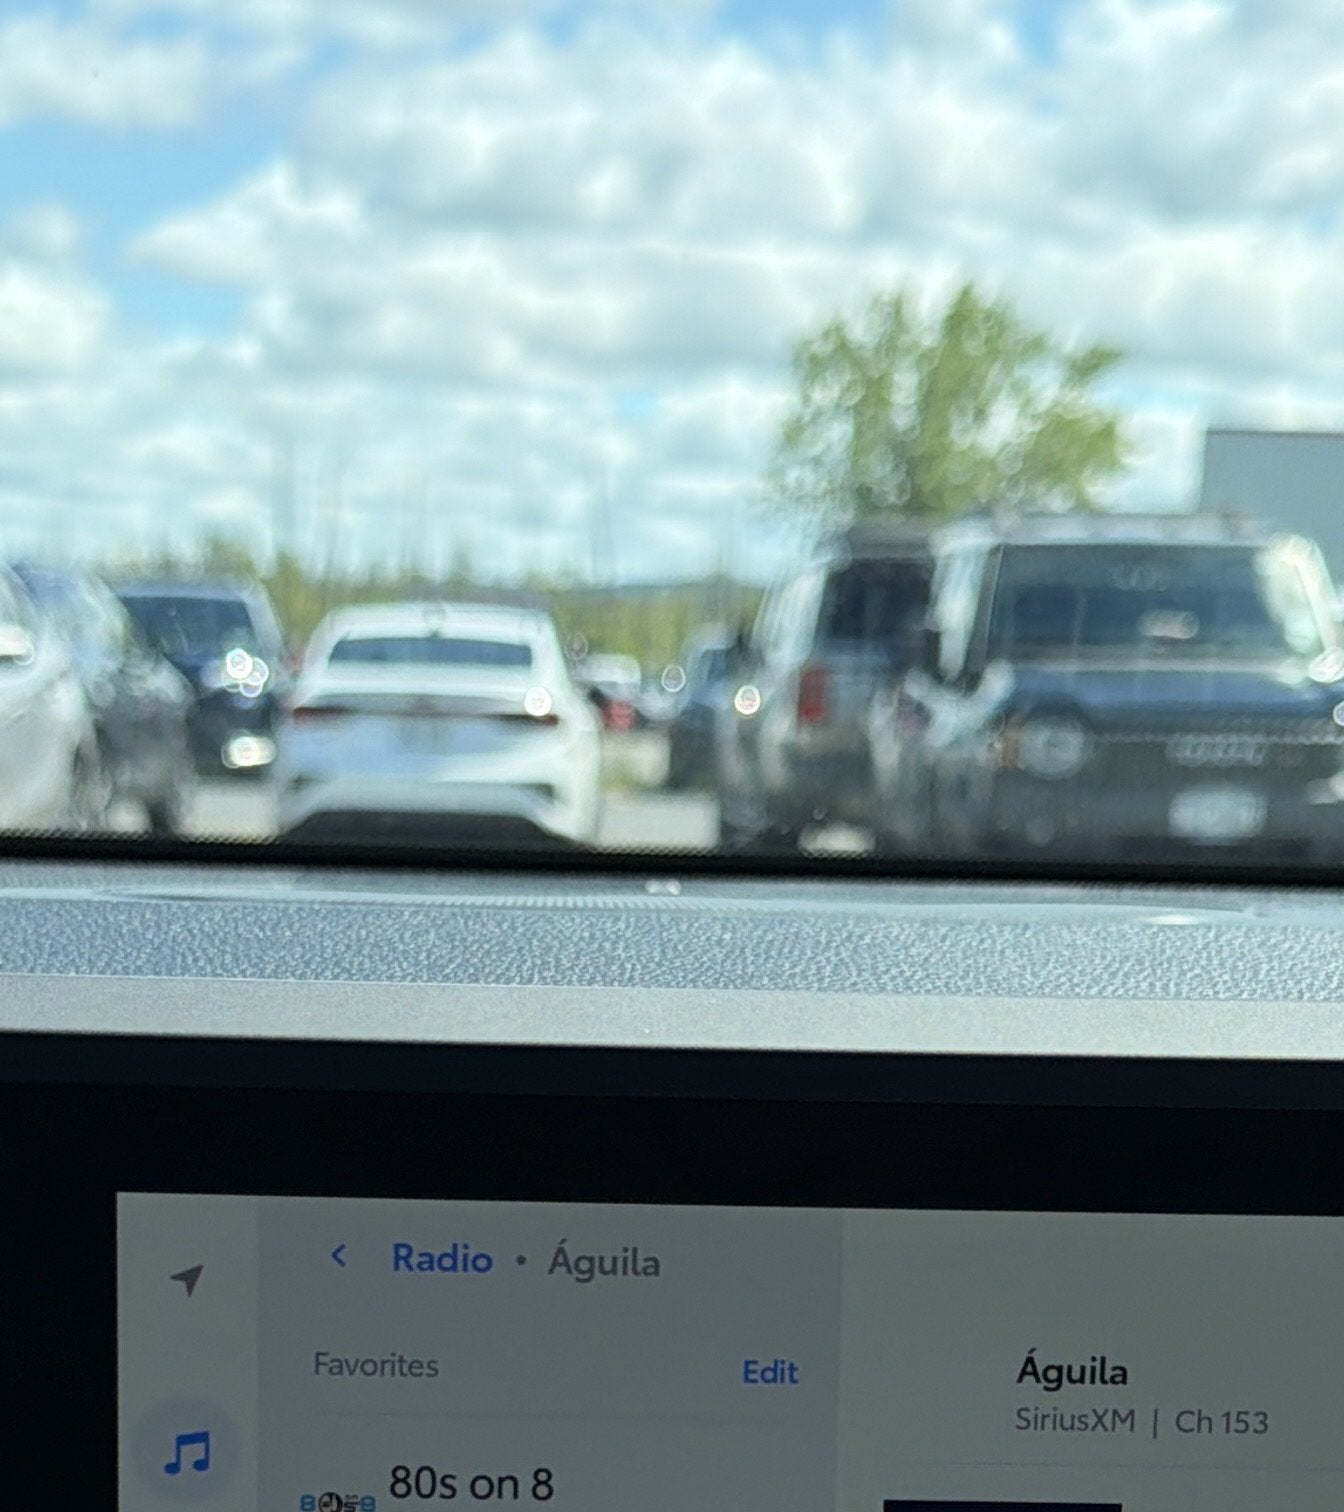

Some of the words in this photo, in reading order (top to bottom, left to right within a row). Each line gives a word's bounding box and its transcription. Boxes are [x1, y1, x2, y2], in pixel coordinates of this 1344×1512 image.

[392, 1241, 494, 1275] Radio
[547, 1237, 661, 1284] Águila
[314, 1350, 440, 1379] Favorites
[743, 1359, 799, 1385] Edit
[1016, 1347, 1129, 1391] Águila
[1015, 1406, 1136, 1434] SiriusXM
[1174, 1408, 1214, 1435] Ch
[1220, 1409, 1270, 1435] 153
[389, 1464, 457, 1501] 80s
[469, 1474, 520, 1501] on
[531, 1467, 555, 1502] 8
